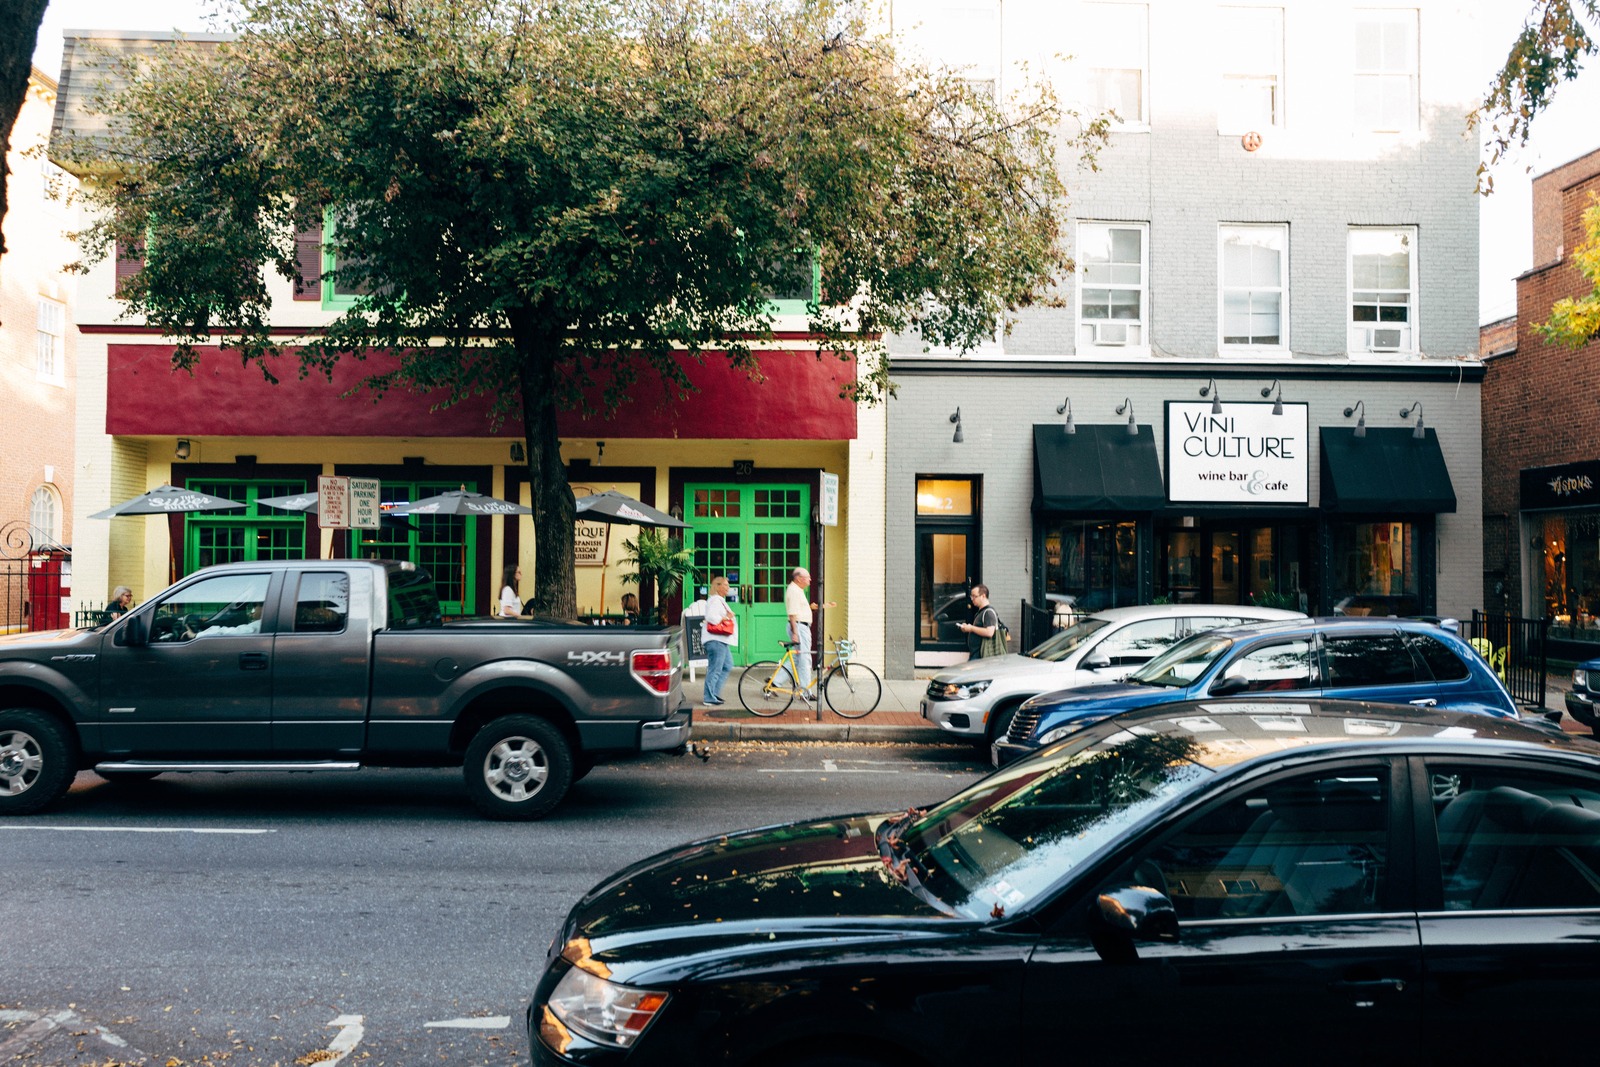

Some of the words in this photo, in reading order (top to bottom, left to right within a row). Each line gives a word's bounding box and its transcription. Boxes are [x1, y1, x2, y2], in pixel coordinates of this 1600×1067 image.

[1183, 411, 1234, 433] VINI
[1183, 435, 1295, 459] CULTURE
[736, 462, 752, 476] 26
[352, 481, 377, 490] SATURDAY
[1198, 470, 1226, 481] wine
[1229, 470, 1249, 481] bar
[1239, 469, 1269, 495] &
[1265, 480, 1289, 491] cafe
[353, 490, 376, 499] PARKING
[359, 499, 370, 507] ONE
[357, 508, 372, 516] HOUR
[358, 517, 372, 525] LIMIT
